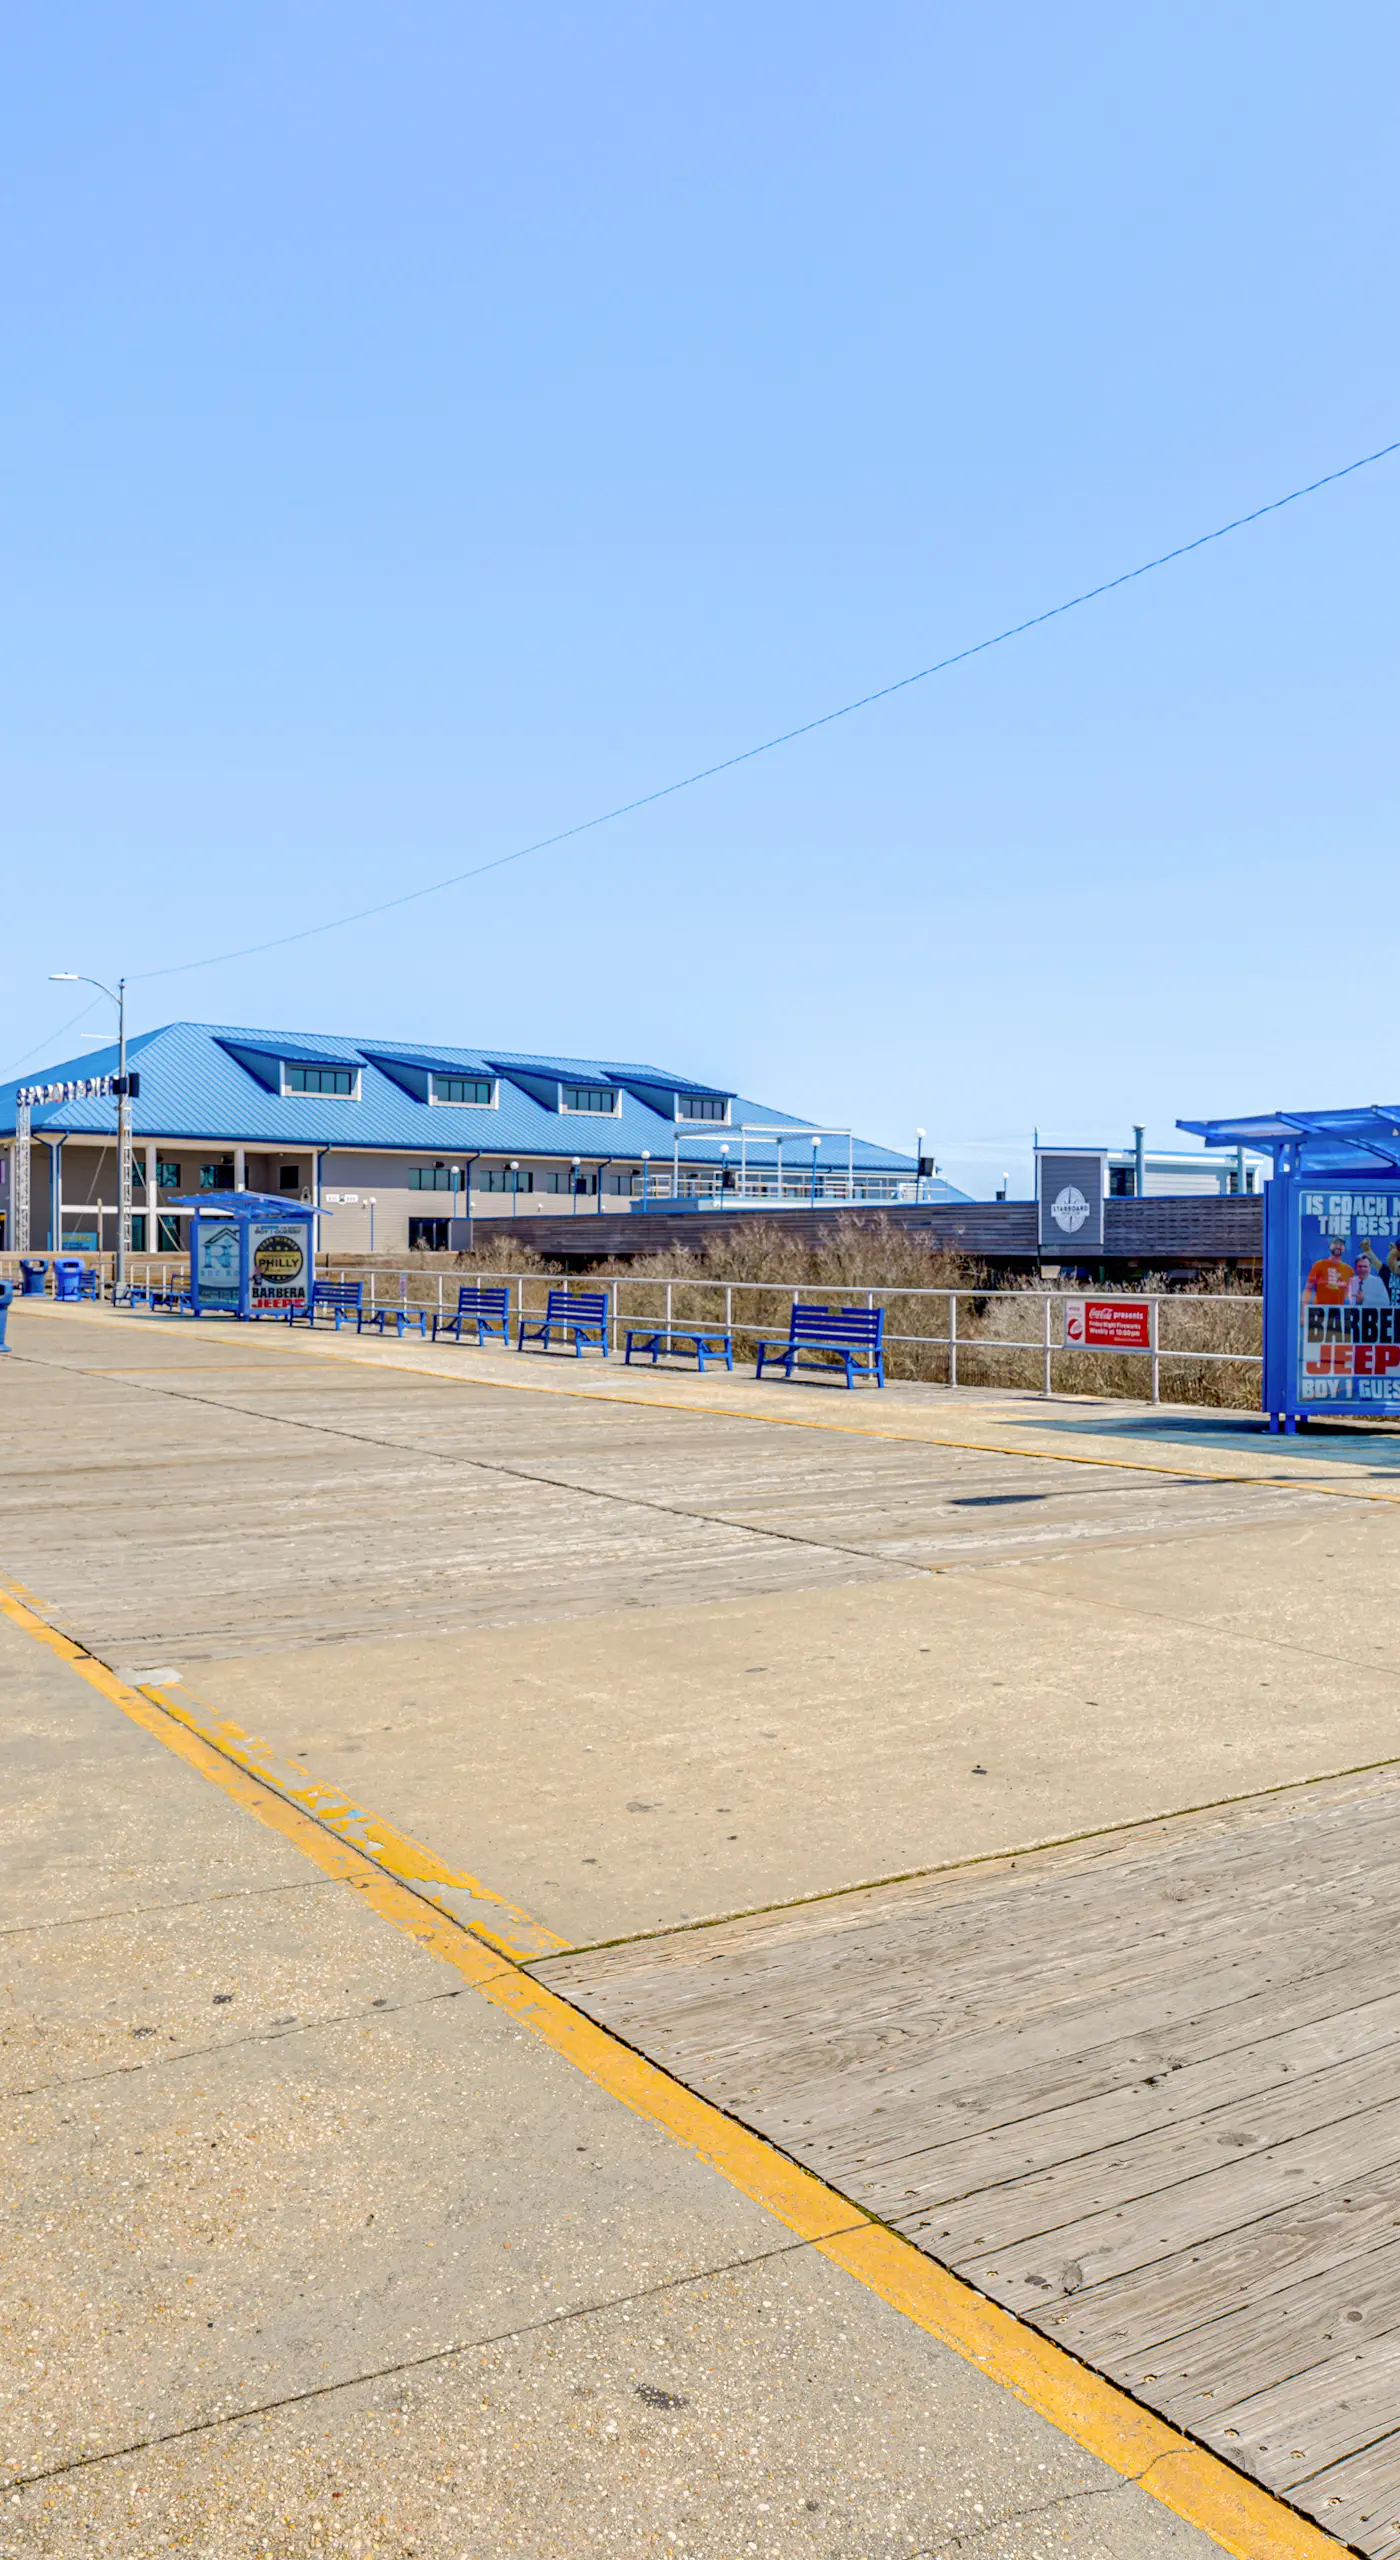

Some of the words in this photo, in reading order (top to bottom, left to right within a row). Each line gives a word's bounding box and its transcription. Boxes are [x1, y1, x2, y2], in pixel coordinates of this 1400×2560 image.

[1306, 1195, 1324, 1215] IS
[1329, 1195, 1388, 1216] COACH
[1318, 1215, 1351, 1235] THE
[1356, 1217, 1400, 1236] BEST
[259, 1259, 299, 1268] PHILLY
[252, 1287, 305, 1298] BARBERA
[1113, 1311, 1144, 1320] presents
[1089, 1327, 1109, 1335] Weekly
[1306, 1345, 1400, 1375] JEEP
[1302, 1379, 1340, 1398] BOY
[1345, 1379, 1353, 1398] I
